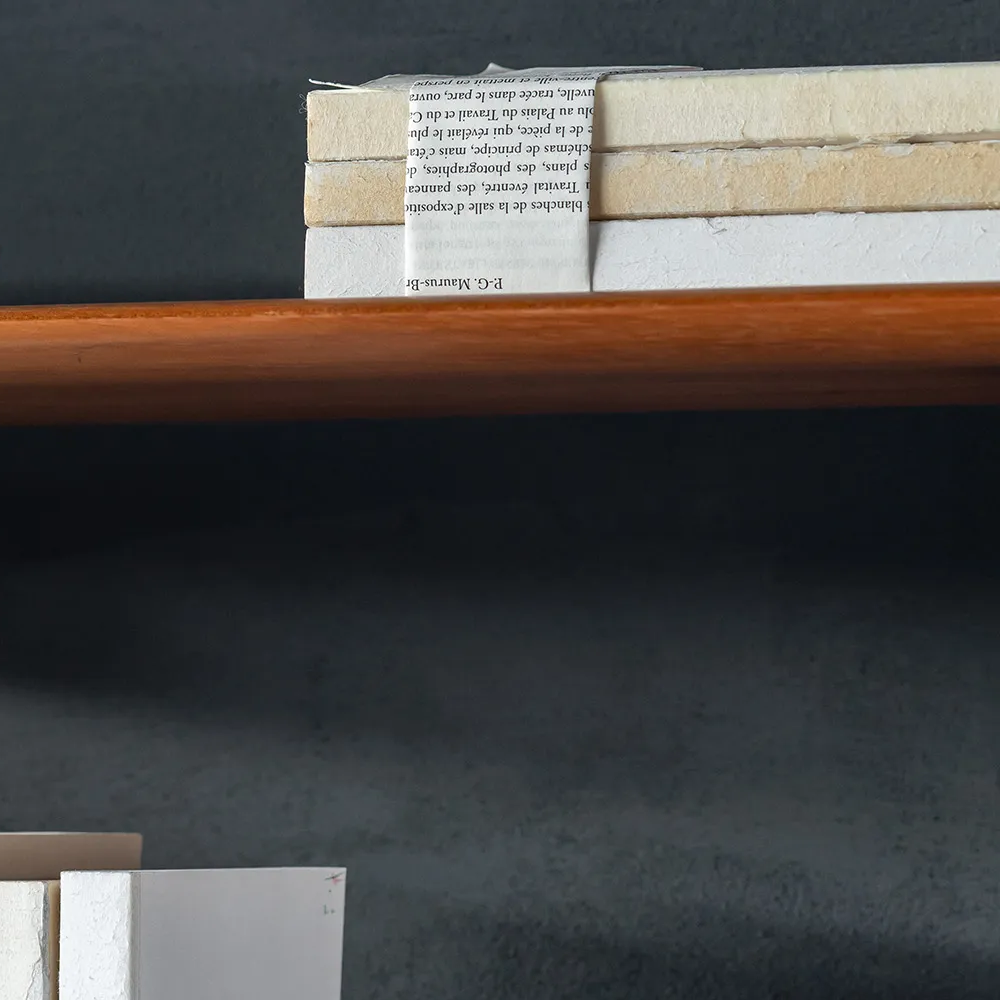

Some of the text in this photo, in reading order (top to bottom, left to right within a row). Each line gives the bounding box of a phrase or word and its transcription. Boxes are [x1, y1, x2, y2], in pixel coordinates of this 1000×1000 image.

[474, 78, 516, 86] mettait
[445, 90, 472, 100] parc,
[476, 92, 485, 103] le
[489, 91, 516, 102] dans
[519, 90, 553, 101] tracée
[558, 88, 595, 100] uvelle,
[427, 111, 441, 122] du
[445, 111, 455, 119] et
[459, 110, 498, 122] Travail
[503, 109, 517, 120] du
[521, 108, 555, 120] Palais
[433, 129, 443, 141] le
[447, 128, 489, 140] révélait
[493, 124, 513, 139] qui
[518, 123, 551, 138] pièce,
[556, 126, 565, 137] la
[570, 126, 583, 137] de
[439, 147, 466, 159] mais
[471, 142, 521, 157] principe,
[526, 145, 540, 157] de
[423, 161, 510, 177] photographies,
[517, 164, 536, 175] des
[543, 160, 577, 175] plans,
[457, 185, 476, 196] des
[482, 182, 528, 195] éventré,
[534, 182, 579, 194] Travital
[469, 203, 494, 214] salle
[499, 202, 509, 214] la
[513, 202, 527, 213] de
[531, 201, 582, 213] blanches
[405, 279, 470, 291] Maurus-Br
